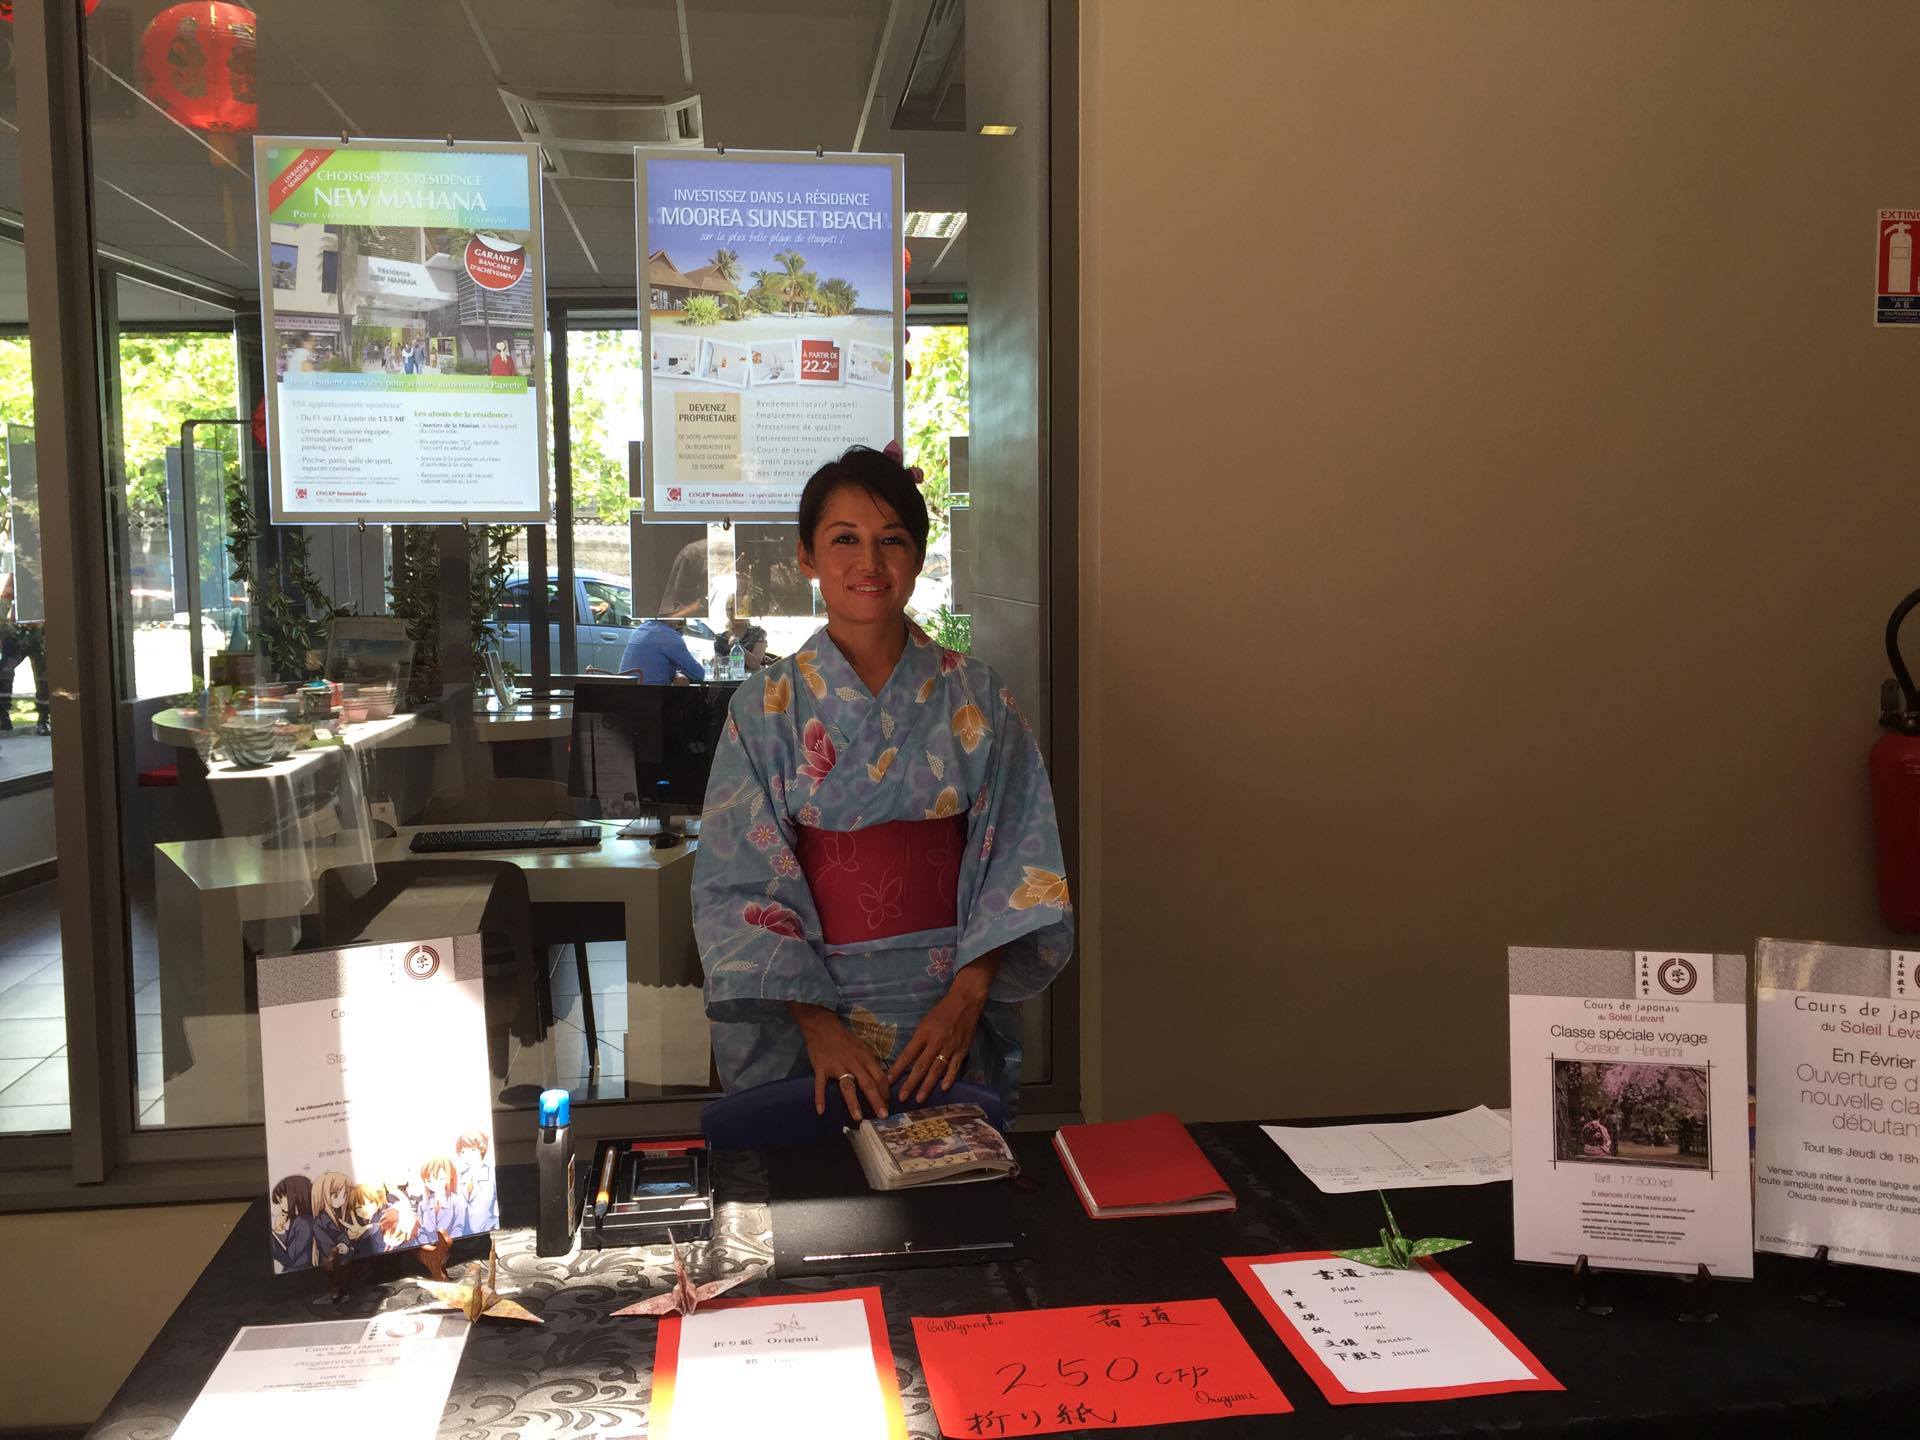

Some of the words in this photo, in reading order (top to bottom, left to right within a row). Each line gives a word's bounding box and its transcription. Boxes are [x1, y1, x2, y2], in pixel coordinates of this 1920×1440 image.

[314, 186, 373, 208] NEW
[376, 188, 488, 212] MAHANA
[674, 188, 747, 203] INVESTISSEZ
[750, 190, 783, 204] DANS
[788, 191, 802, 205] LA
[806, 188, 870, 206] RÉSIDENCE
[661, 206, 744, 227] MOOREA
[748, 208, 817, 229] SUNSET
[822, 210, 882, 230] BEACH
[474, 248, 520, 265] GARANTIE
[478, 258, 511, 272] BANCAIRE
[808, 350, 829, 359] PARTIR
[830, 351, 838, 360] DE
[802, 360, 831, 373] 22.2
[689, 403, 727, 412] DEVENEZ
[678, 412, 737, 423] PROPRIÉTAIRE
[1583, 999, 1613, 1010] Cours
[1619, 1001, 1631, 1011] de
[1636, 1002, 1680, 1014] japonais
[1794, 995, 1847, 1015] Cours
[1859, 1002, 1880, 1016] de
[1608, 1012, 1633, 1022] Soleil
[1634, 1013, 1665, 1023] Levant
[1550, 1024, 1596, 1039] Classe
[1599, 1026, 1655, 1042] spéciale
[1658, 1031, 1708, 1046] voyage
[1821, 1022, 1836, 1031] du
[1840, 1020, 1882, 1036] Soleil
[1634, 1042, 1683, 1058] Hanami
[1832, 1048, 1854, 1064] En
[1860, 1050, 1917, 1069] Février
[1796, 1063, 1897, 1091] Ouverture
[1800, 1089, 1883, 1111] nouvelle
[1832, 1112, 1920, 1137] débutan
[1802, 1141, 1826, 1154] Tout
[1828, 1144, 1843, 1155] les
[1846, 1147, 1876, 1160] Jeudi
[1879, 1150, 1894, 1162] de
[1897, 1153, 1919, 1164] 18h
[1621, 1175, 1633, 1185] 17
[1758, 1175, 1781, 1186] toute
[1783, 1177, 1825, 1193] simplicité
[1826, 1184, 1848, 1195] avec
[1850, 1187, 1874, 1198] notre
[1766, 1165, 1793, 1177] Venez
[1795, 1170, 1817, 1180] vous
[1819, 1171, 1843, 1183] initier
[1854, 1177, 1877, 1187] cette
[1879, 1178, 1910, 1191] langue
[1859, 1199, 1884, 1210] partir
[1886, 1202, 1899, 1212] du
[1330, 1285, 1357, 1293] Fude
[713, 1338, 753, 1348] 折り紙
[766, 1335, 820, 1344] Origami
[995, 1356, 1139, 1396] 250
[967, 1402, 1118, 1435] 折り紙
